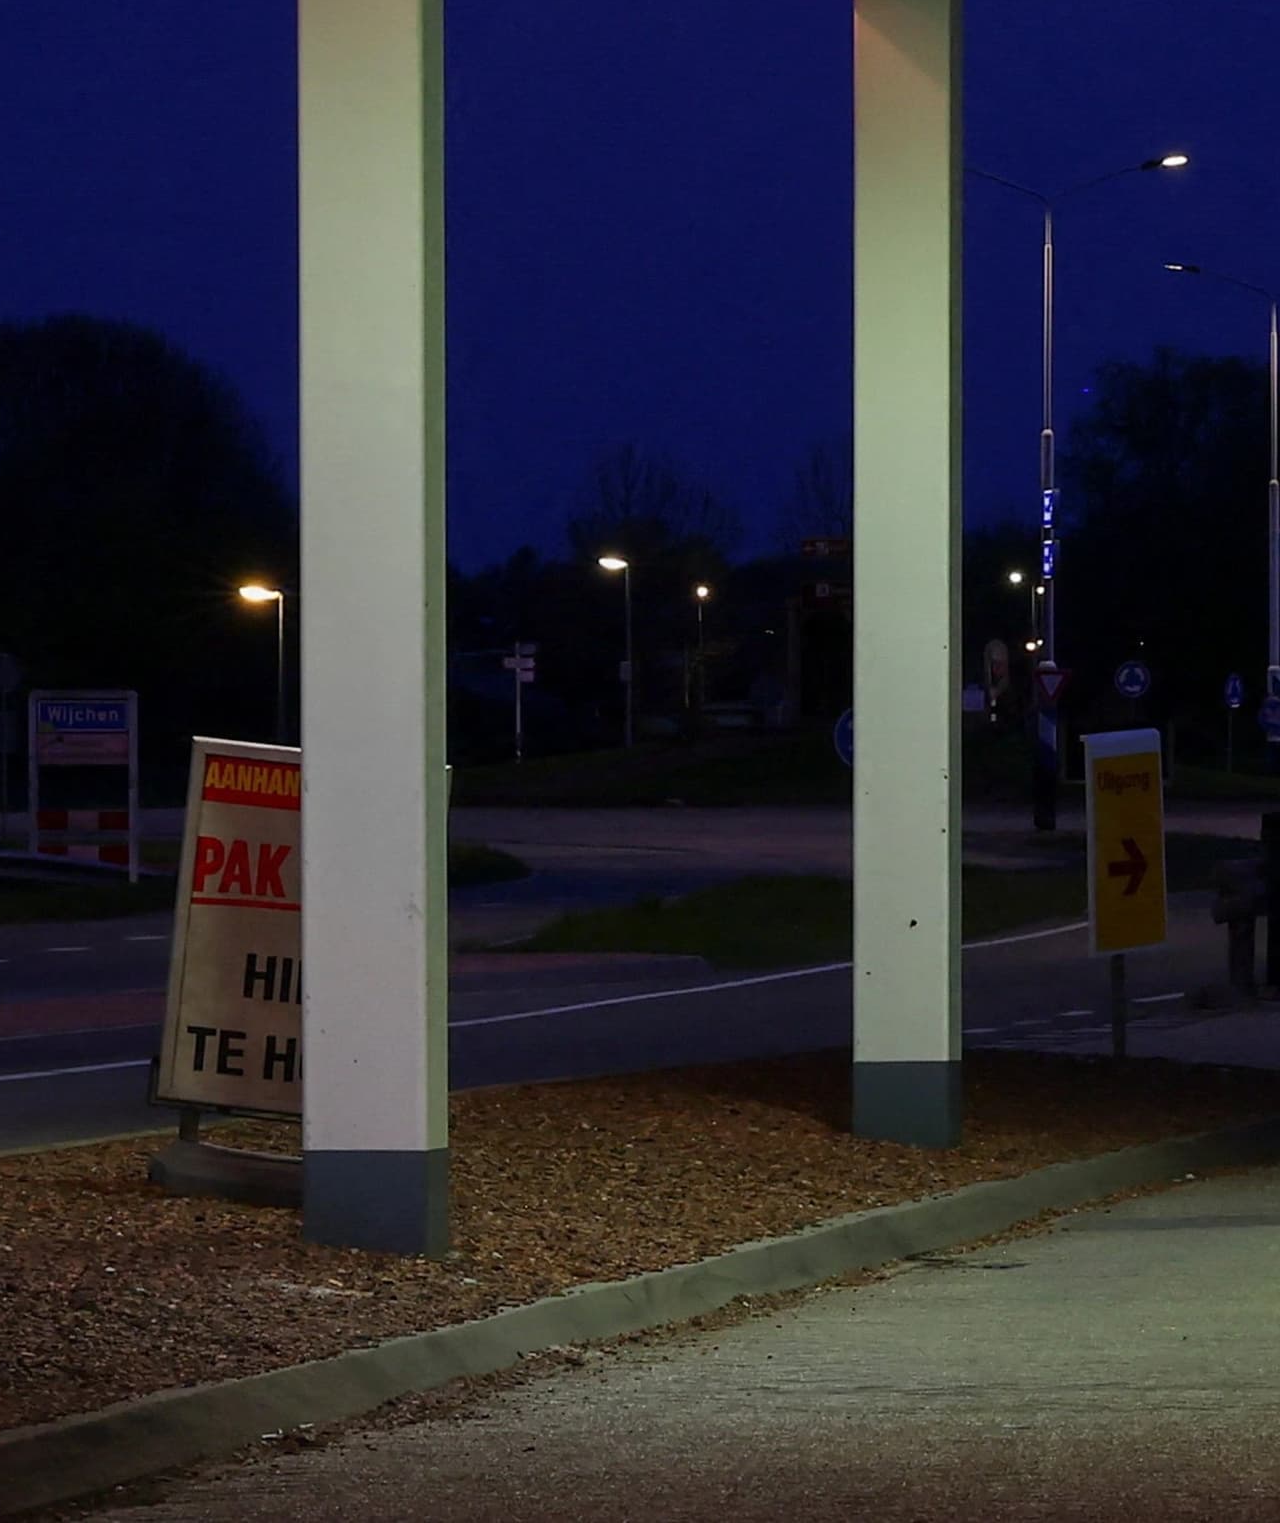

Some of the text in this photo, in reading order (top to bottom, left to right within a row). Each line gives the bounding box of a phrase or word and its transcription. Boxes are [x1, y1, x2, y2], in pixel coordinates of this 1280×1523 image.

[48, 705, 119, 726] Wijchen
[192, 836, 292, 897] PAK
[187, 1026, 302, 1082] TE H
